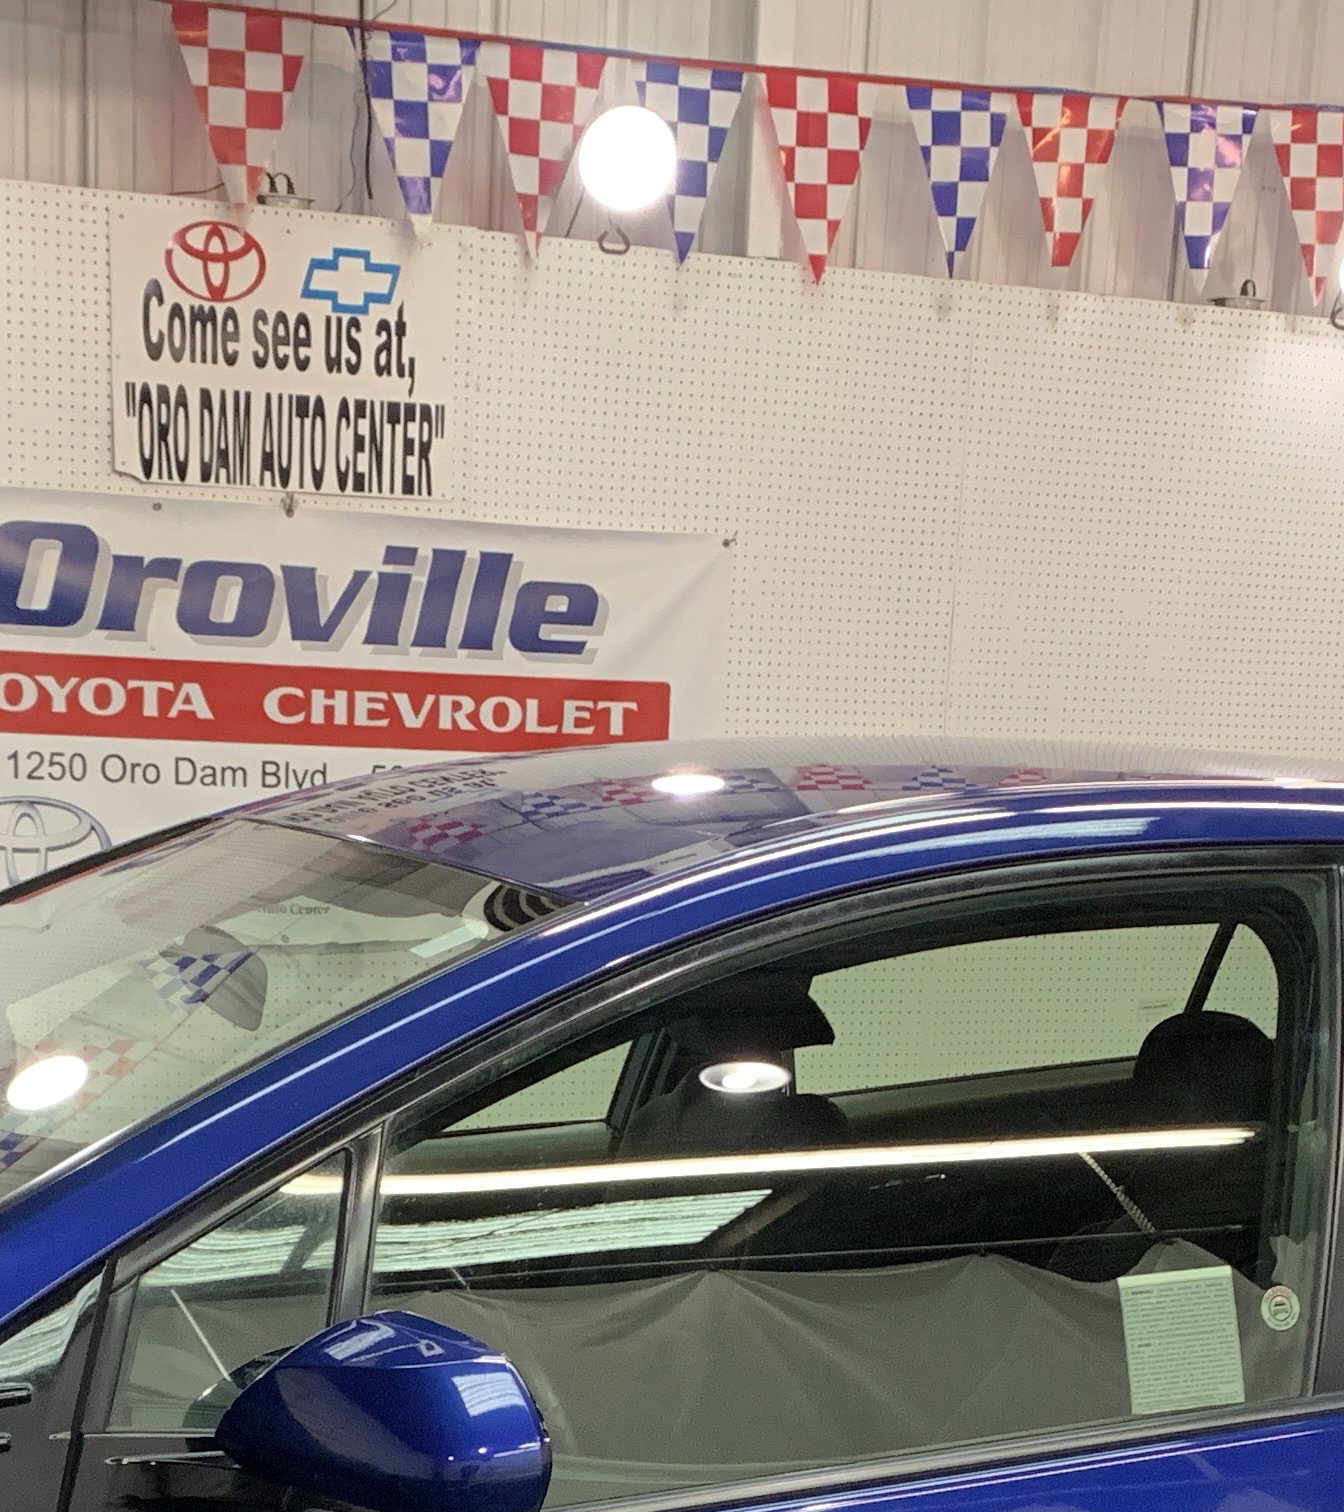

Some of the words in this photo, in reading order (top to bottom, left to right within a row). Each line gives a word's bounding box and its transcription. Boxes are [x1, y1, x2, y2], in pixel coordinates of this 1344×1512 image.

[142, 276, 239, 366] Come
[252, 305, 312, 372] see
[324, 314, 362, 377] us
[374, 299, 416, 397] at,
[124, 381, 190, 483] "ORO
[198, 388, 252, 486] DAM
[258, 393, 327, 492] AUTO
[335, 397, 445, 498] CENTER"
[262, 684, 639, 738] CHEVROLET
[6, 749, 88, 783] 1250
[100, 752, 161, 786] Oro
[174, 756, 248, 789] Dam
[260, 761, 328, 790] Blvd
